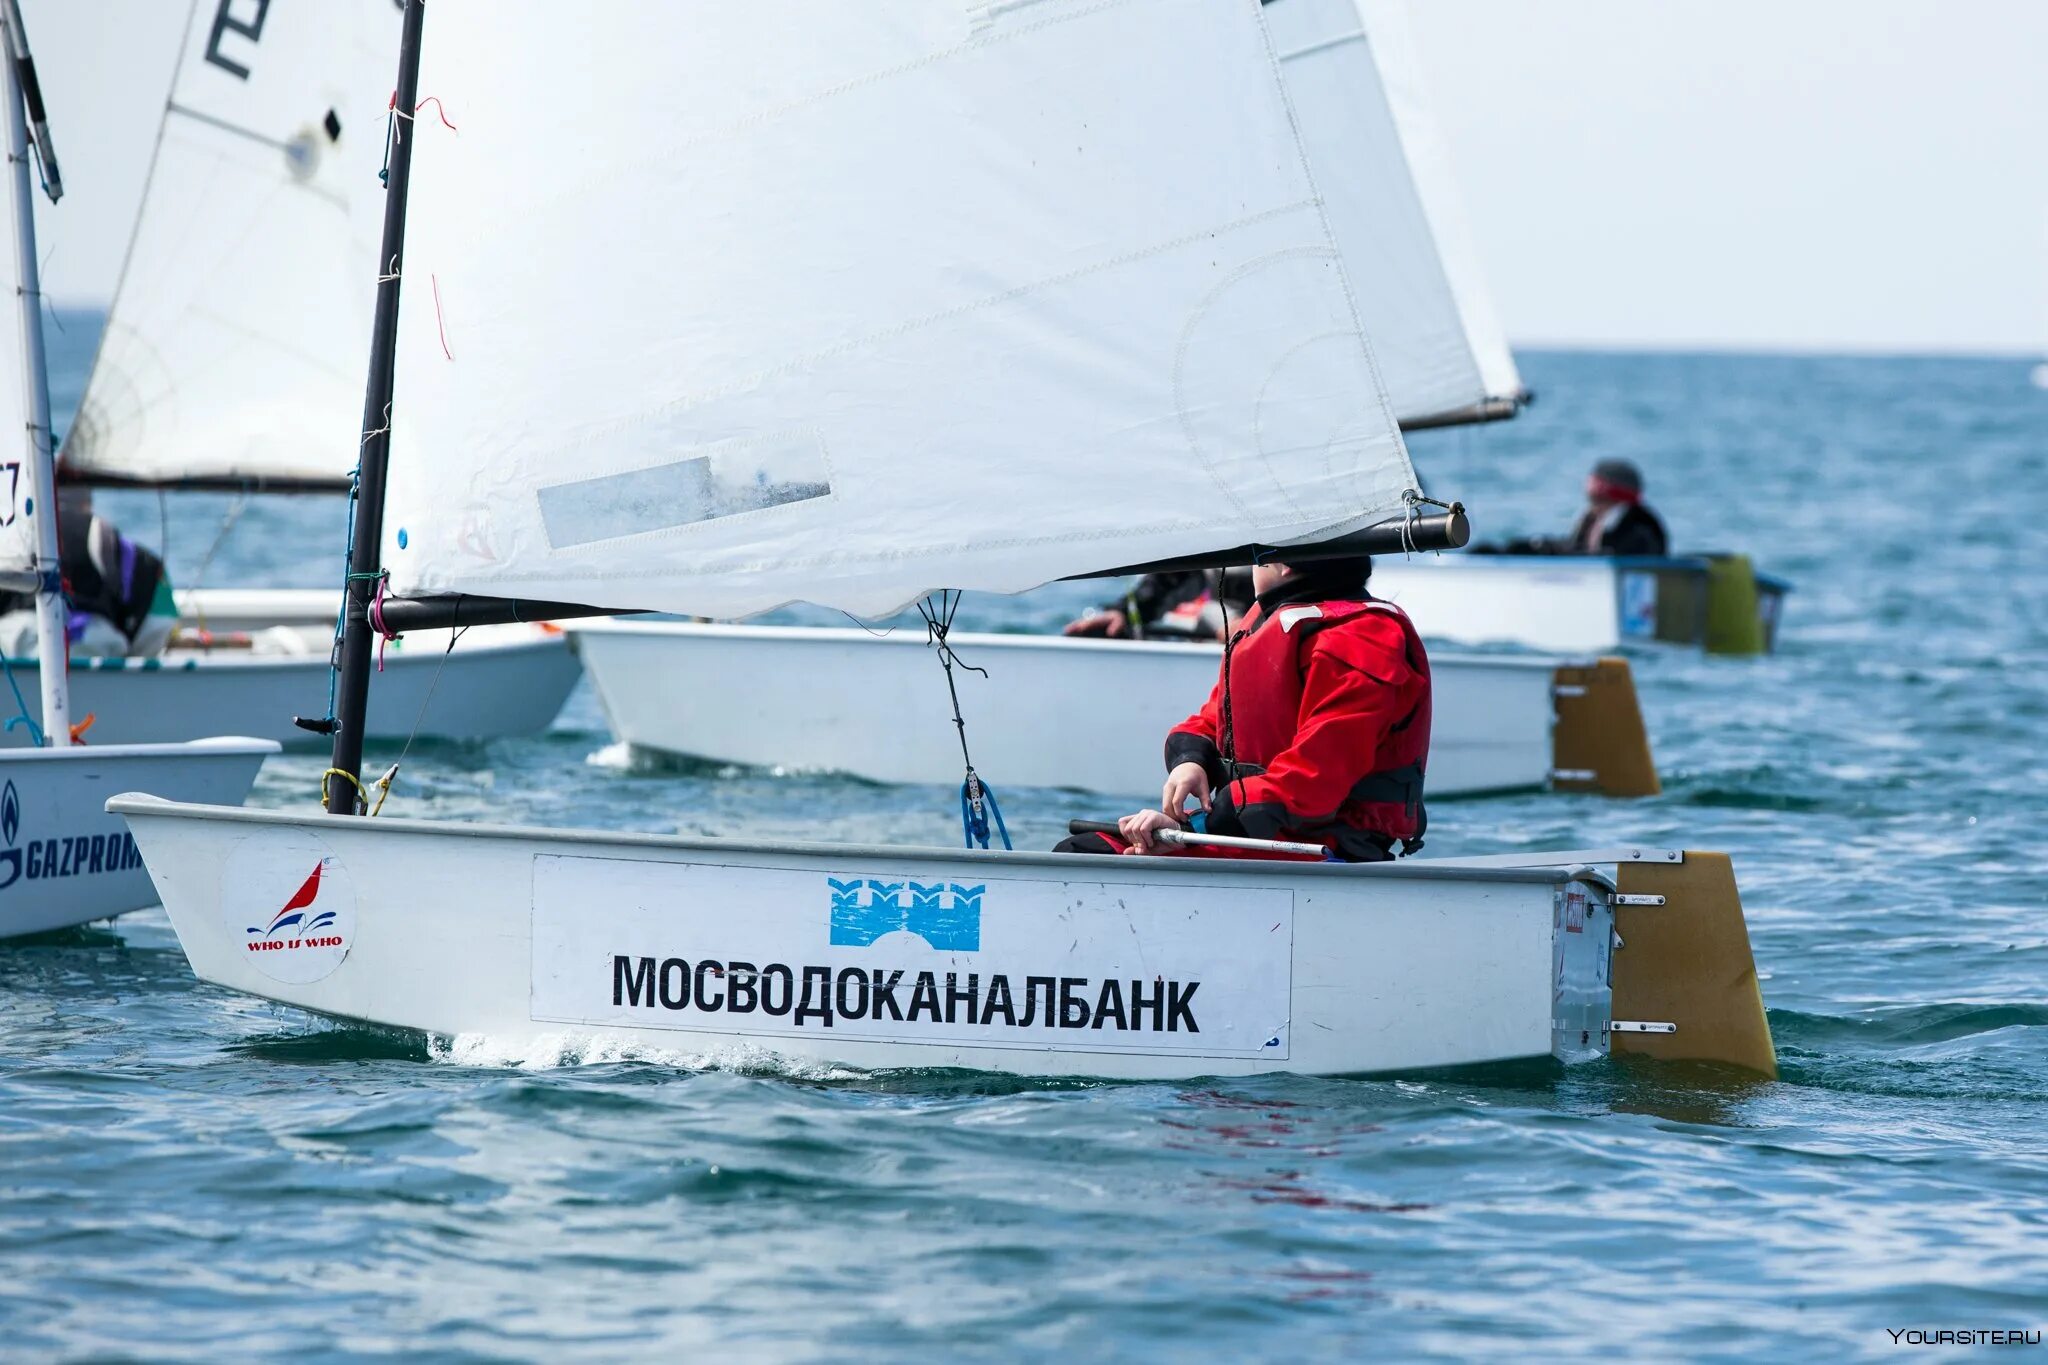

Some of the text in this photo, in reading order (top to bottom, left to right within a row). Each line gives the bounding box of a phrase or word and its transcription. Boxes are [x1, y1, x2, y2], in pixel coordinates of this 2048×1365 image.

[26, 831, 143, 880] GAZPROM
[247, 936, 343, 951] WHO IS WHO
[612, 954, 1201, 1033] МОСВОДОКАНАЛБАНК
